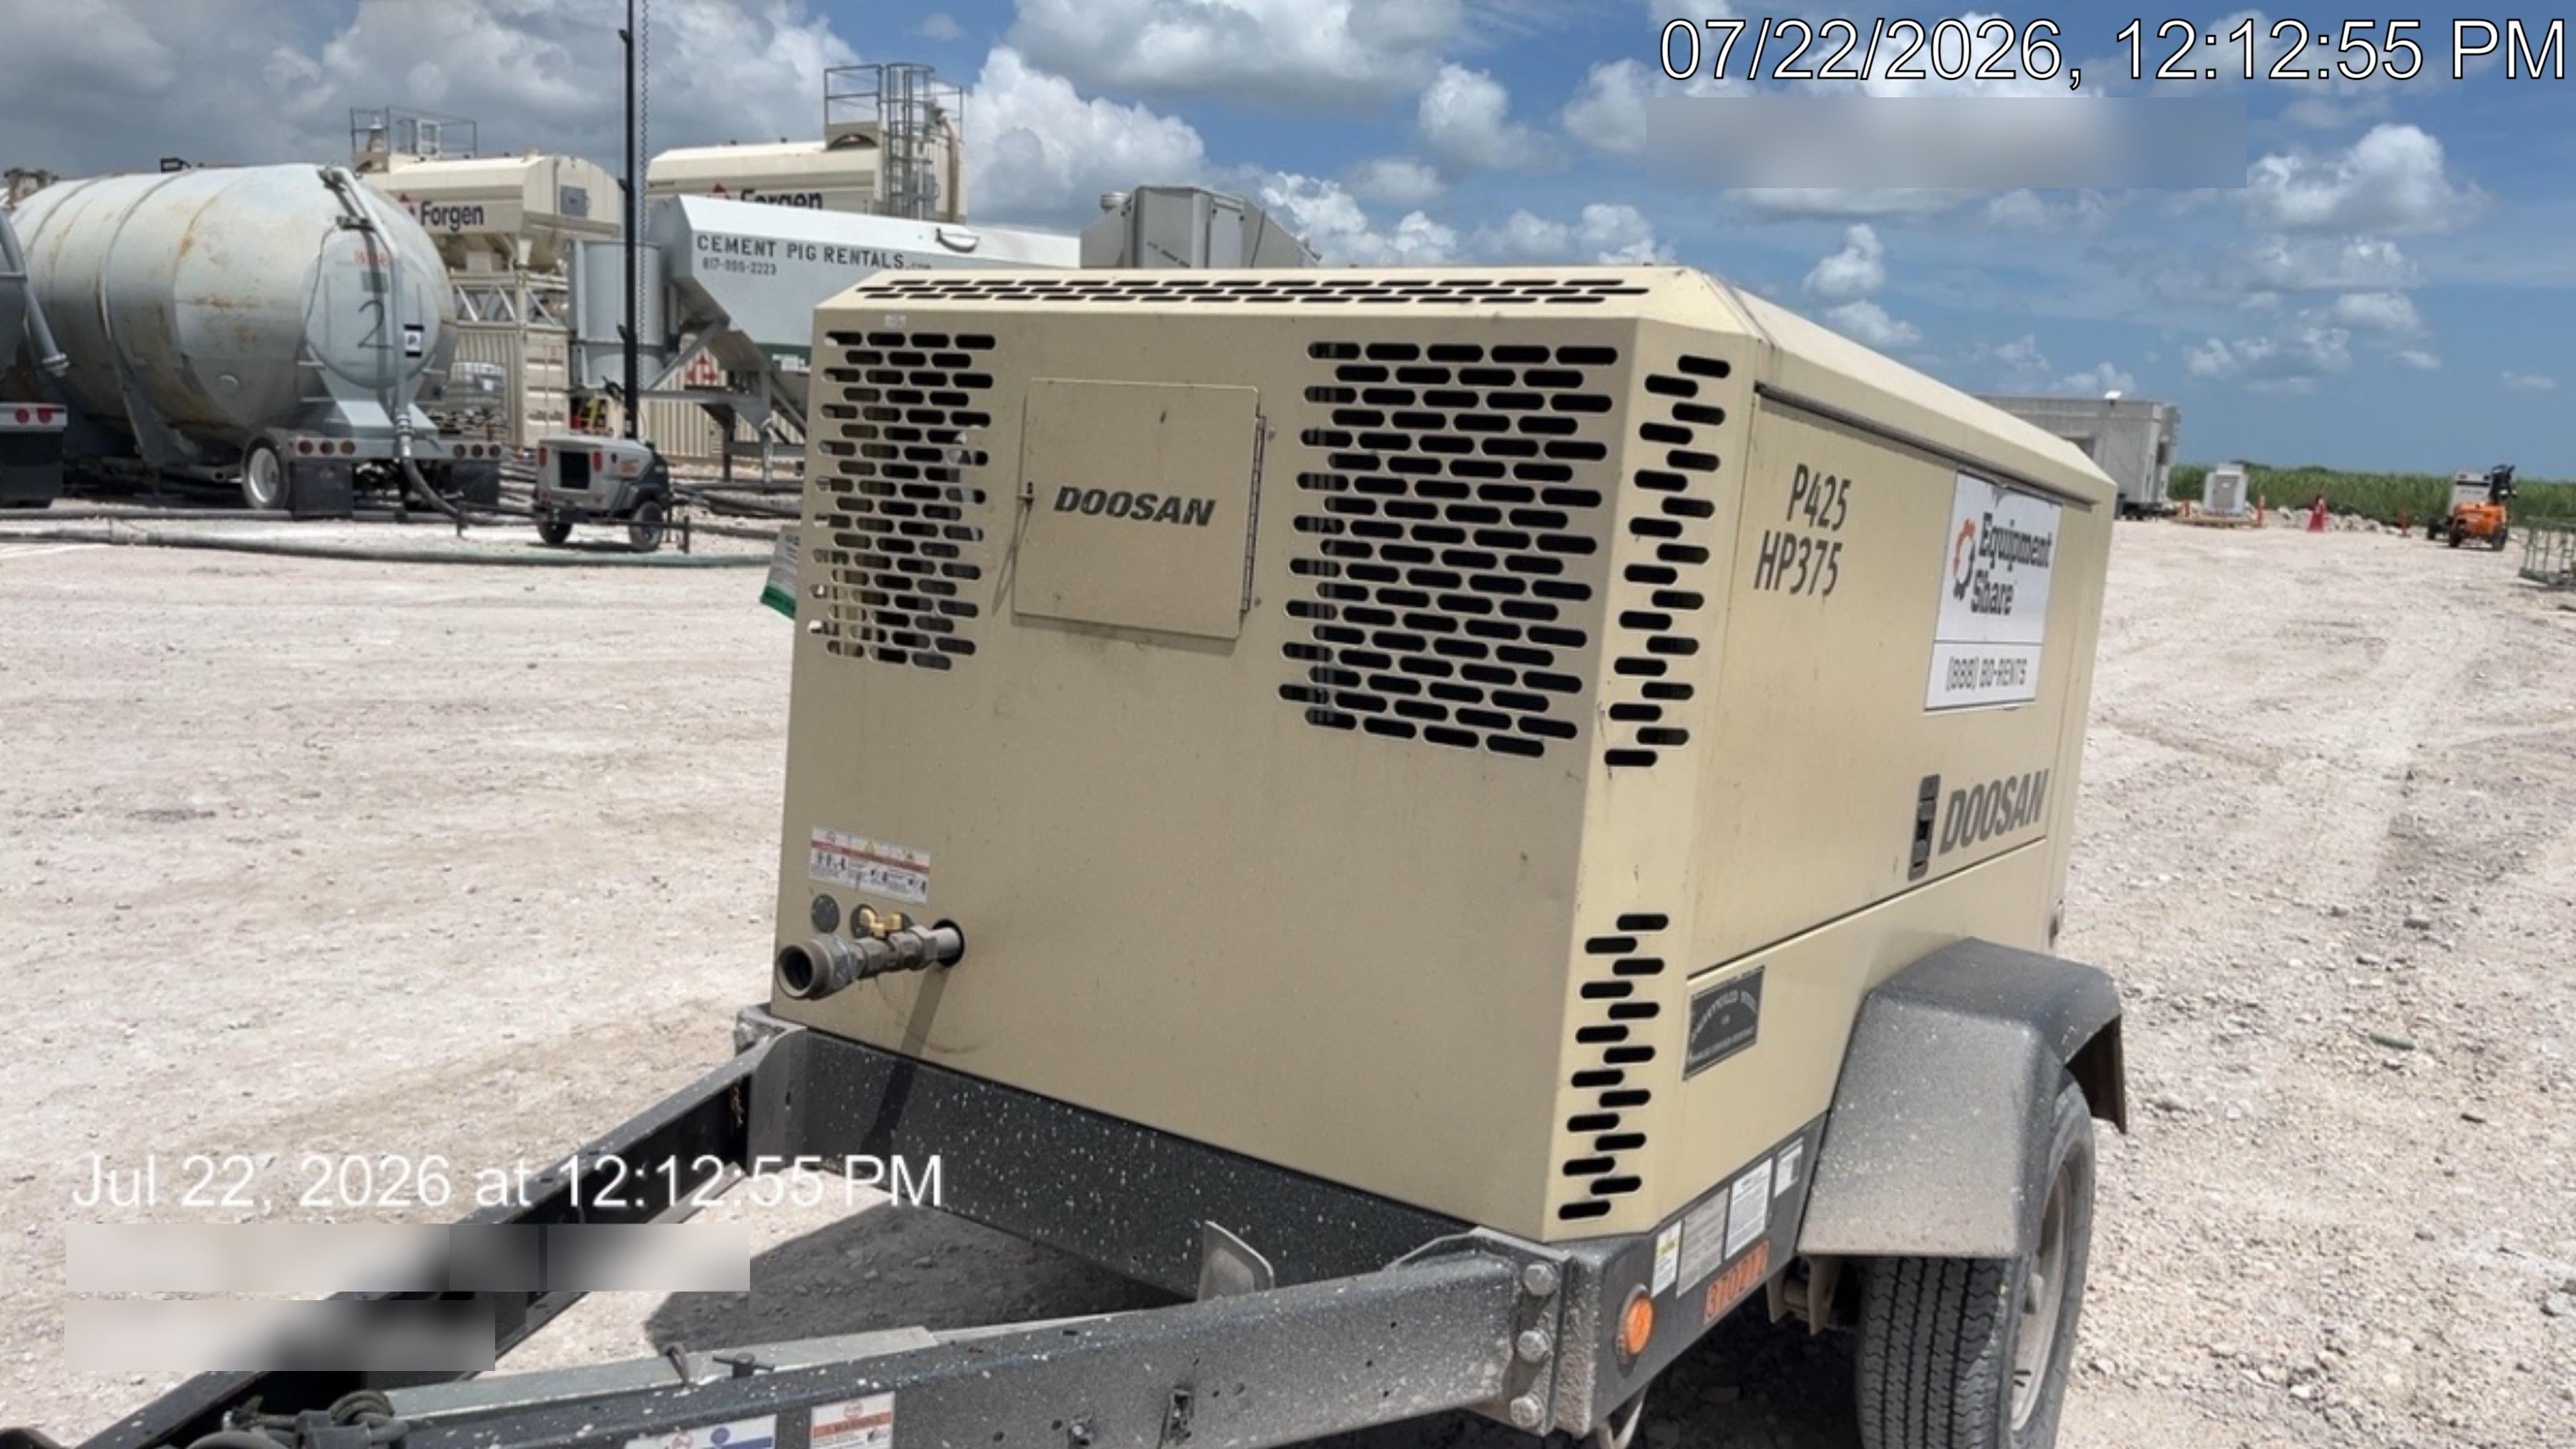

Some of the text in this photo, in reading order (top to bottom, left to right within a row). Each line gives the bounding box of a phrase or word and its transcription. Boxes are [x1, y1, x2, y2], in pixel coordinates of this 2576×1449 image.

[421, 200, 484, 231] Forgen
[697, 235, 777, 258] CEMENT
[787, 244, 817, 262] PIG
[824, 246, 904, 270] RENTALS
[357, 300, 394, 349] 2
[1054, 485, 1216, 527] DOOSAN
[1786, 462, 1852, 532] P425
[1754, 529, 1843, 598] HP375
[1979, 512, 2053, 572] Equipment
[1971, 569, 2014, 615] Share
[1938, 767, 2050, 856] DOOSAN
